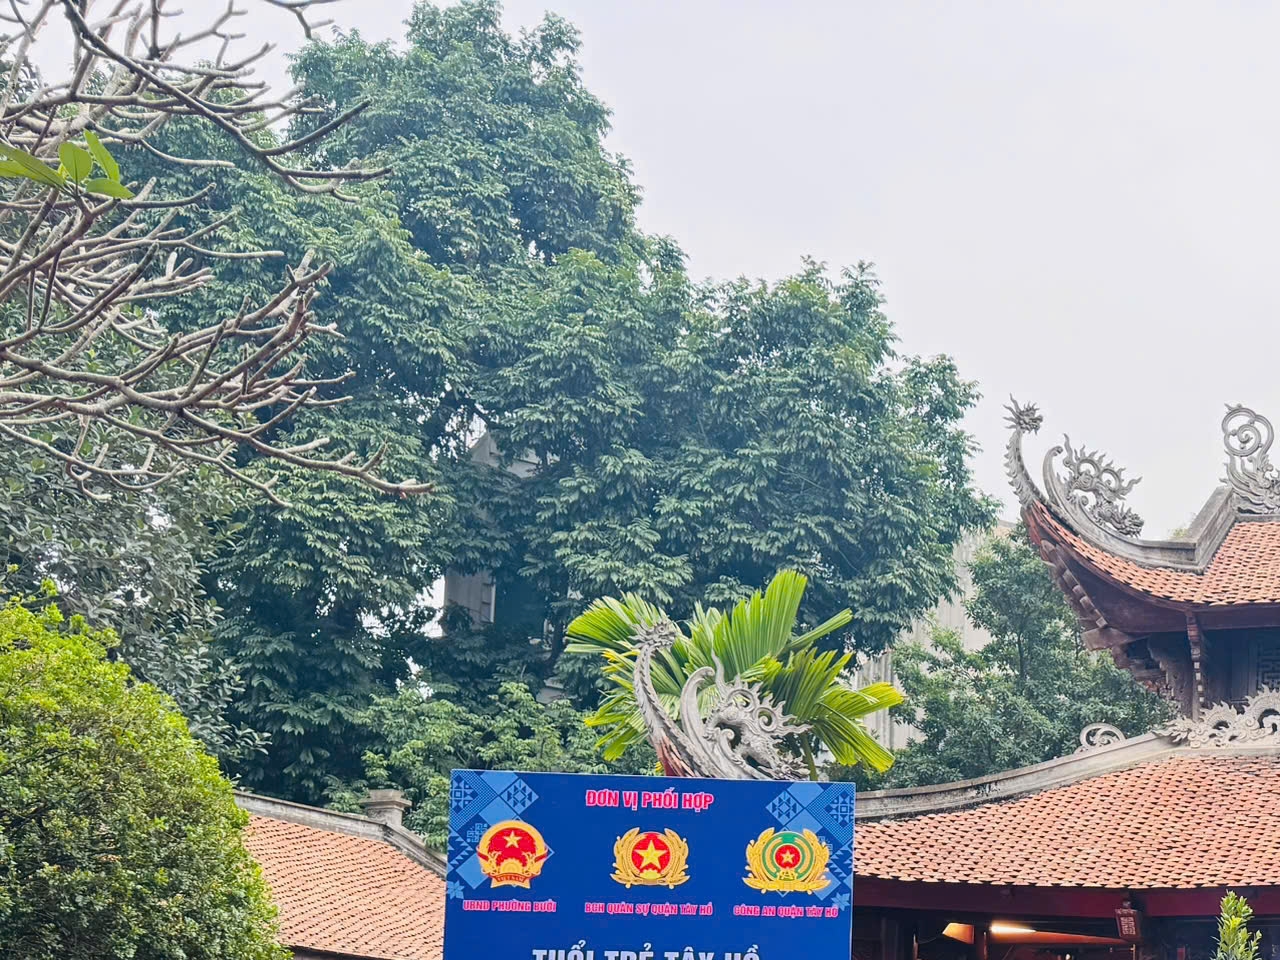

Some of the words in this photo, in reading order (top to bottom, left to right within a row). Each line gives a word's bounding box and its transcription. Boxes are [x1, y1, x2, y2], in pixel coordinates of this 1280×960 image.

[586, 789, 619, 807] ĐƠN
[623, 791, 638, 811] VỊ
[642, 787, 678, 808] PHỐI
[682, 792, 714, 812] HỢP
[463, 900, 490, 911] UBND
[491, 899, 531, 912] PHƯỜNG
[533, 899, 556, 912] BƯỞI
[585, 903, 605, 913] BCH
[607, 902, 634, 914] QUÂN
[635, 903, 650, 916] SỰ
[651, 903, 678, 916] QUẬN
[680, 903, 698, 915] TÂY
[699, 902, 713, 915] HỒ
[734, 904, 760, 916] CÔNG
[761, 906, 776, 916] AN
[777, 905, 804, 918] QUẬN
[806, 905, 823, 917] TÂY
[825, 904, 838, 918] HỒ
